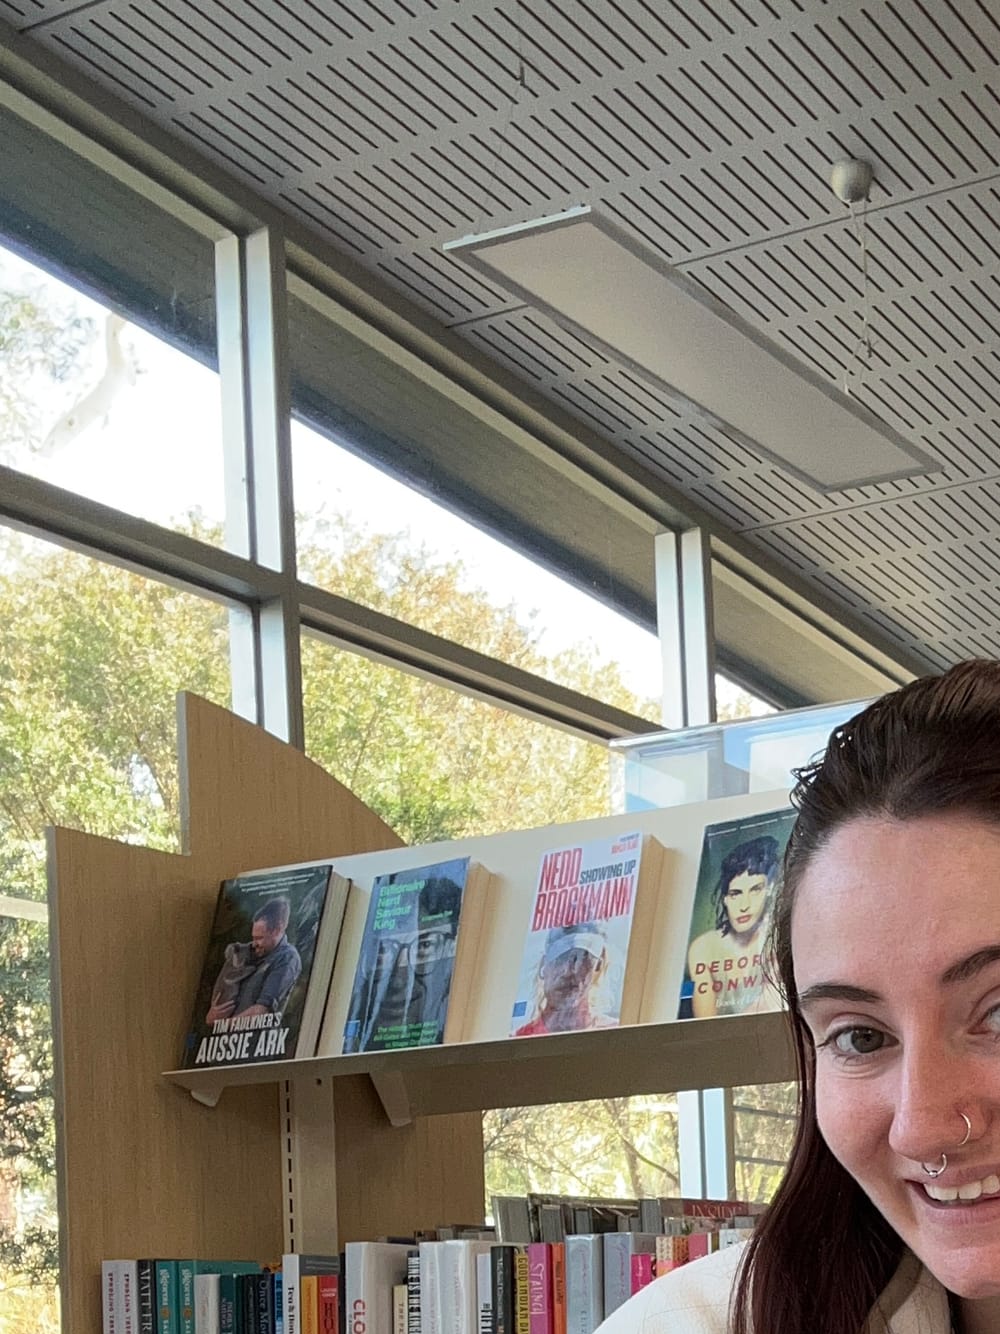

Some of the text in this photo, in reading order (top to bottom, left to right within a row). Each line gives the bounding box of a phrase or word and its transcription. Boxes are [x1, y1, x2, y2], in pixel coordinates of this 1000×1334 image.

[538, 847, 583, 893] NEDD
[579, 858, 637, 885] SHOWING UP
[531, 874, 635, 932] BROCKMANN
[212, 1011, 282, 1034] TIM FAULKNER'S
[195, 1027, 289, 1064] AUSSIE ARK
[408, 1256, 420, 1279] MINE
[517, 1256, 528, 1281] GOOD
[138, 1268, 153, 1310] MATT
[258, 1280, 269, 1308] Once
[409, 1280, 420, 1293] IS
[408, 1293, 420, 1311] THE
